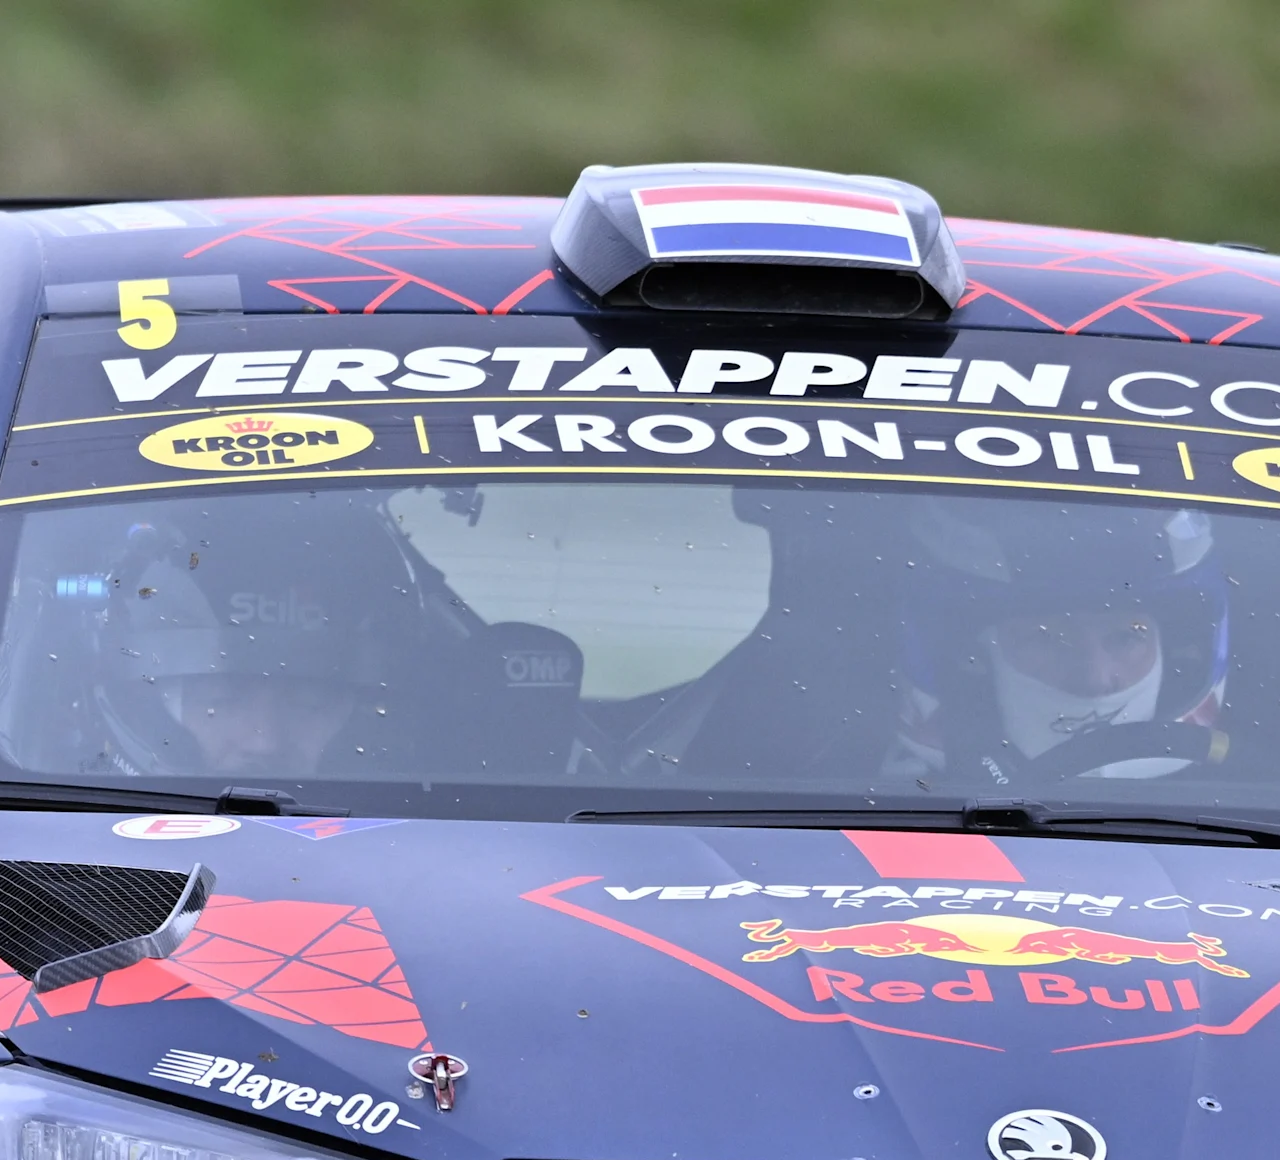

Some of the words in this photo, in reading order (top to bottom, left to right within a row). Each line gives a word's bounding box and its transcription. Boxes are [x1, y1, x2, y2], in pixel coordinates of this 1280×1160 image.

[116, 278, 178, 351] 5
[172, 430, 340, 455] KROON
[474, 412, 1141, 476] KROON-OIL
[220, 448, 295, 467] OIL
[229, 588, 326, 632] Stilo
[504, 655, 572, 684] OMP
[143, 819, 212, 835] E
[832, 898, 1115, 918] RACING
[807, 966, 995, 1004] Red
[1022, 971, 1202, 1013] Bull
